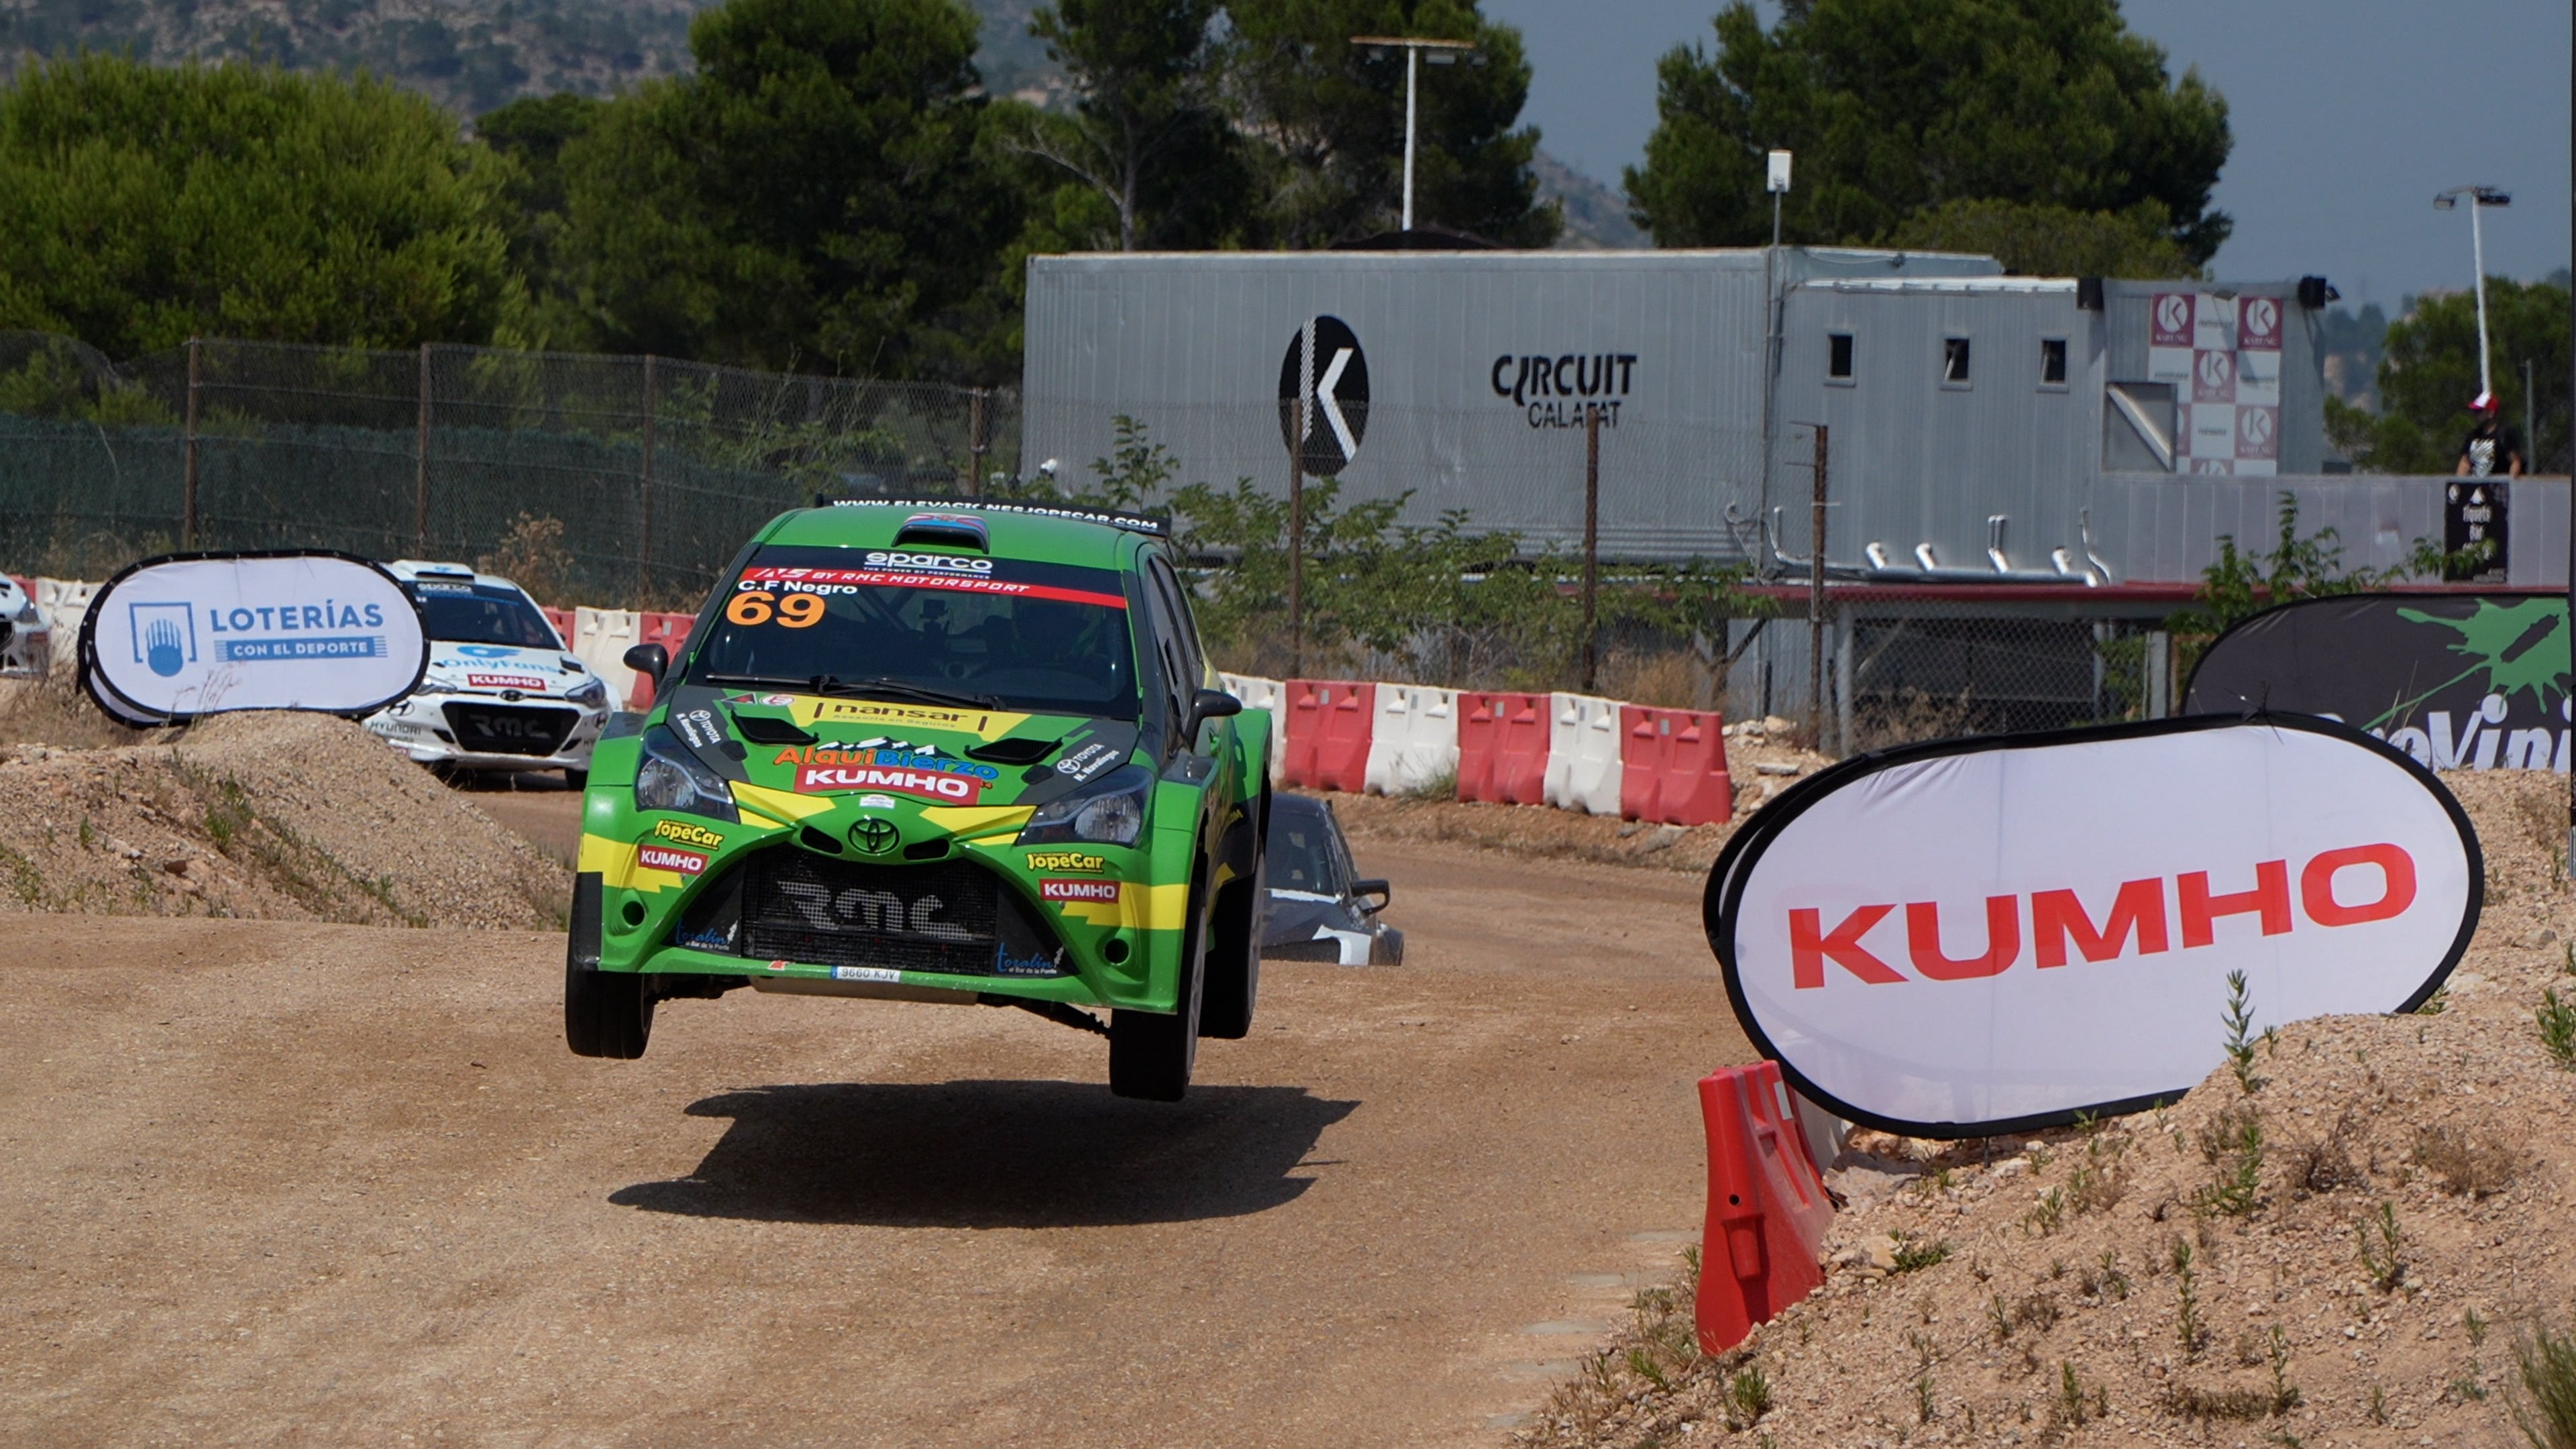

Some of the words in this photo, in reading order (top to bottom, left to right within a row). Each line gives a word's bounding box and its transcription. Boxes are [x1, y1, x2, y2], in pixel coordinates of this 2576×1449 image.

[1491, 354, 1638, 407] CIRCUIT
[864, 552, 993, 571] sparco
[738, 580, 780, 591] C.F
[784, 580, 858, 595] Negro
[811, 572, 838, 580] BY
[841, 572, 885, 582] RMC
[889, 576, 1030, 593] MOTORSPORT
[210, 598, 384, 632] LOTERÍAS
[726, 590, 826, 629] 69
[233, 644, 268, 656] CON
[273, 643, 291, 655] EL
[295, 641, 368, 655] DEPORTE
[471, 675, 542, 687] KUMHO
[834, 704, 968, 722] nansar
[700, 719, 721, 745] TOYOTA
[2314, 693, 2571, 774] oVini
[1072, 743, 1106, 762] TOYOTA
[773, 747, 999, 780] AlquiBierzo
[805, 769, 969, 798] KUMHO
[654, 819, 725, 847] JopeCar
[641, 849, 702, 871] KUMHO
[1026, 853, 1104, 871] JopeCar
[1044, 883, 1116, 899] KUMHO
[1788, 842, 2418, 989] KUMHO
[841, 968, 870, 978] 9660
[873, 969, 896, 979] KJV
